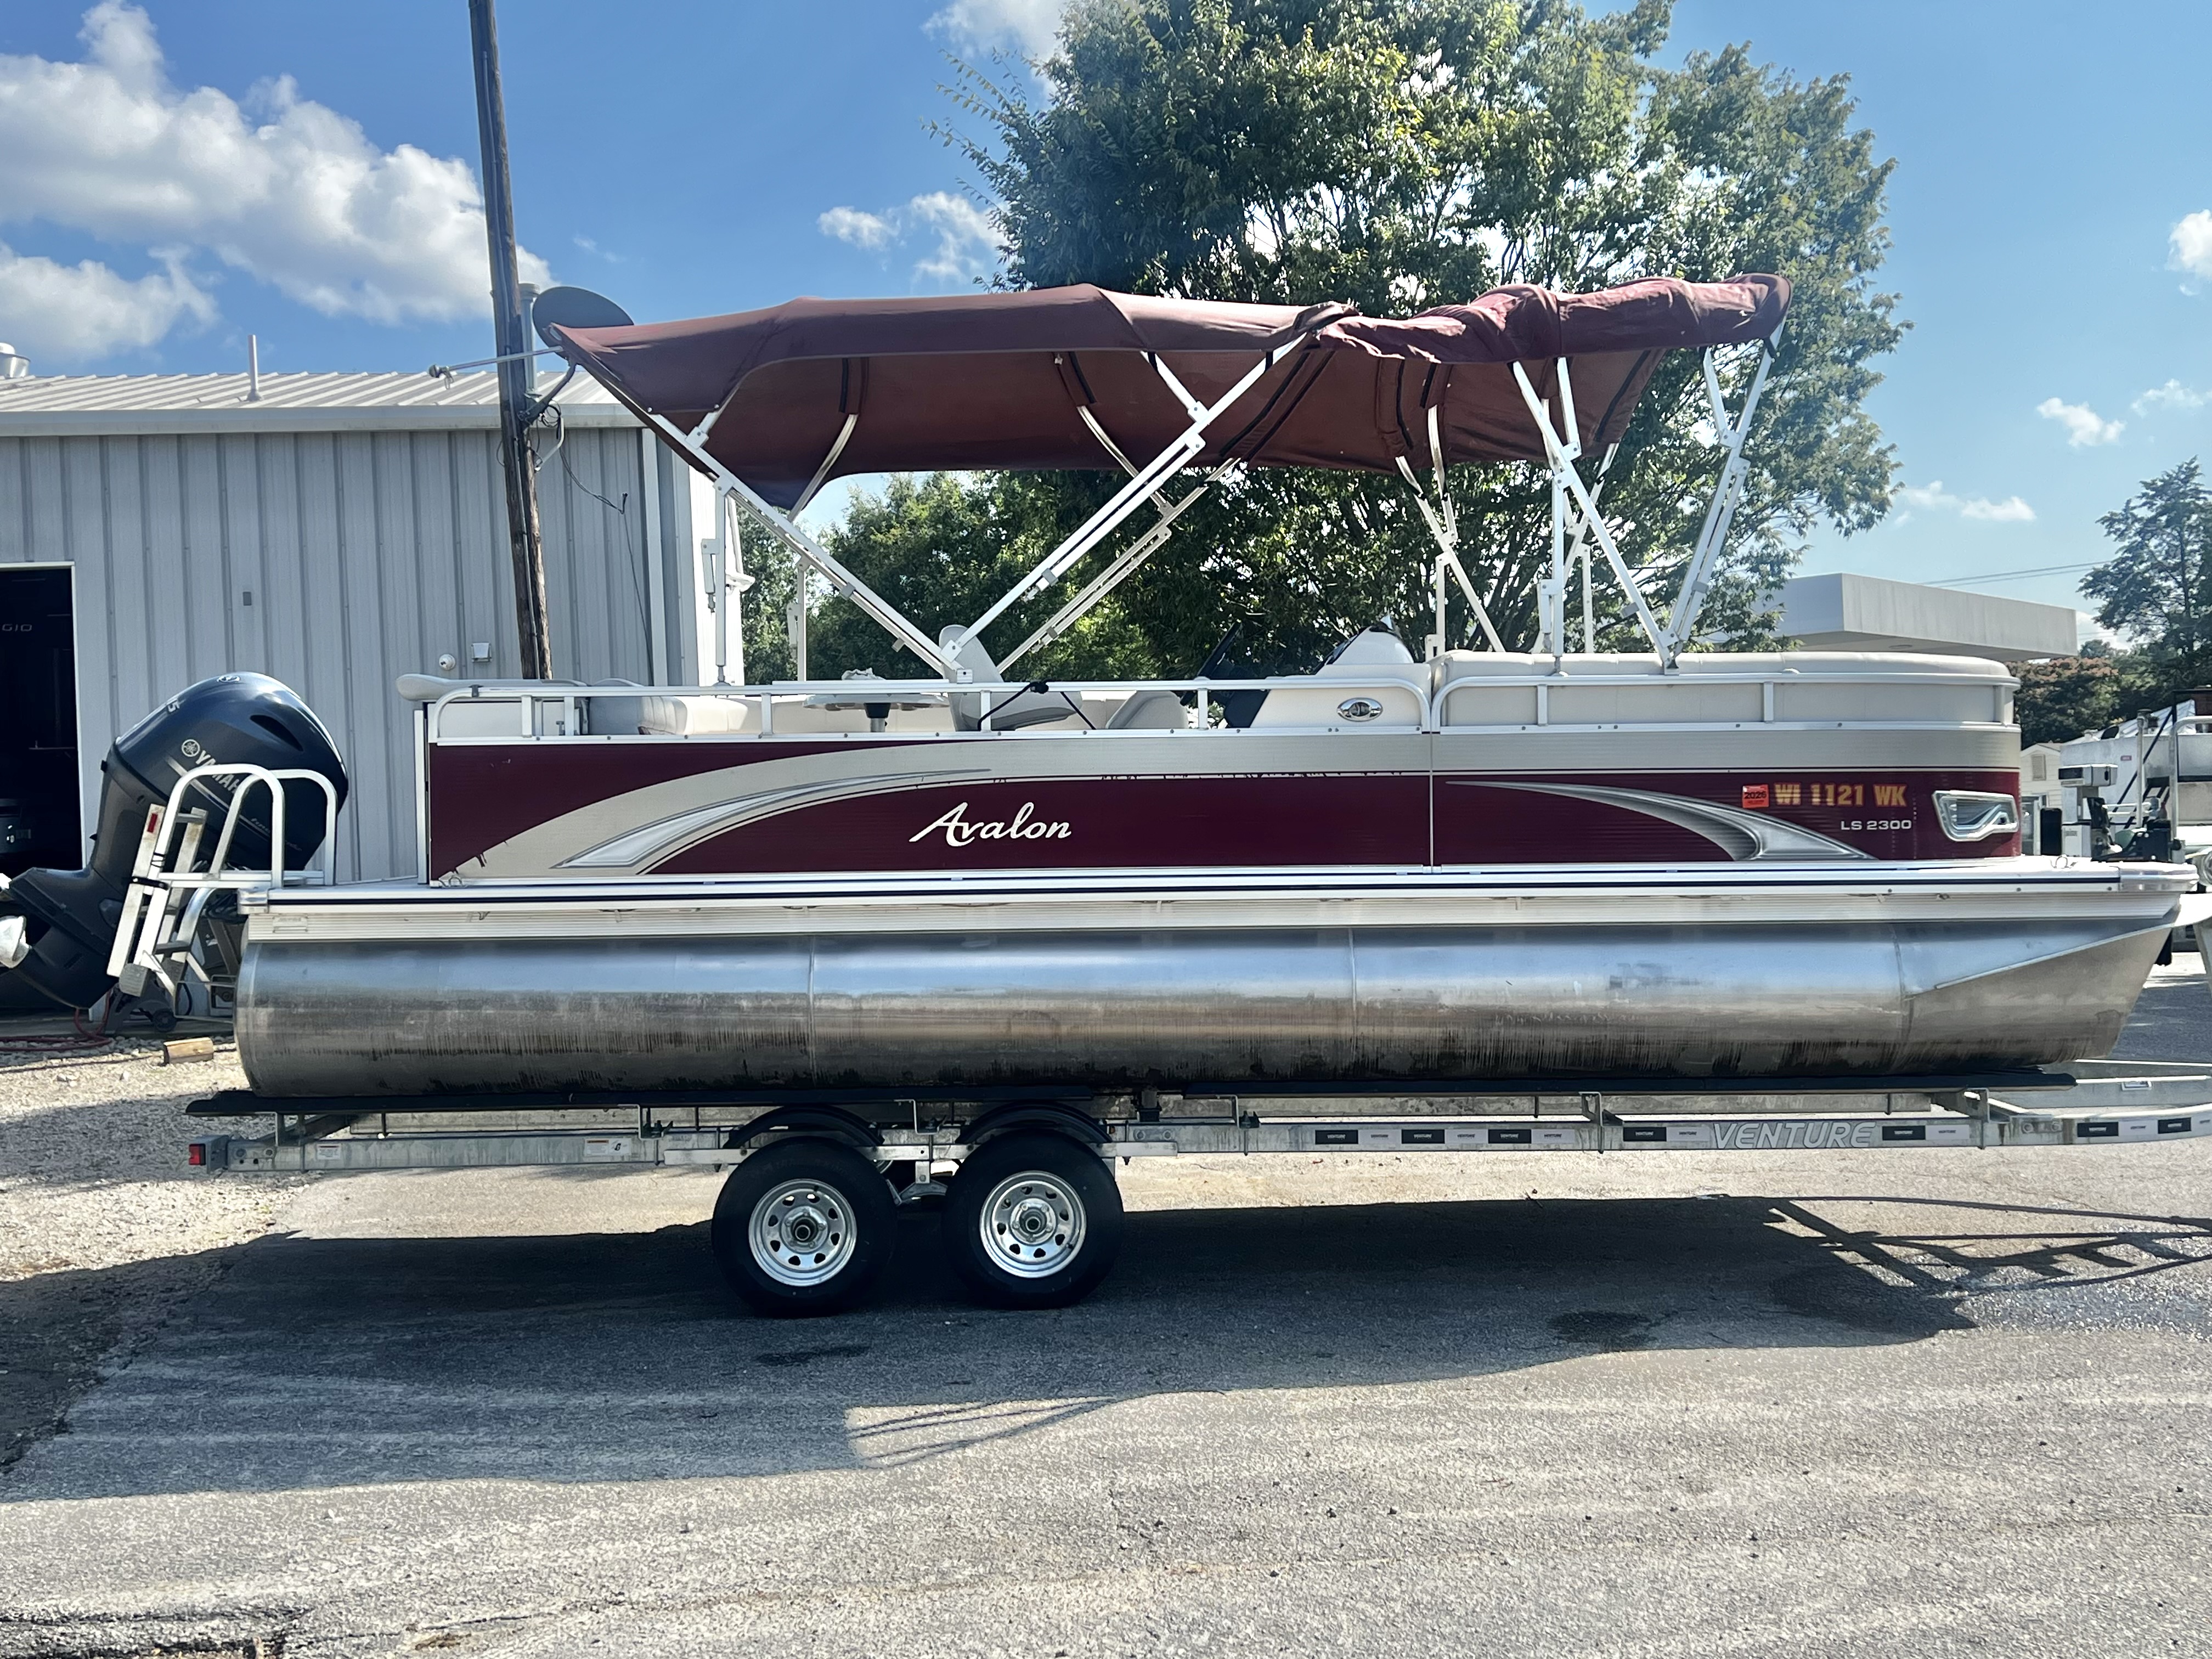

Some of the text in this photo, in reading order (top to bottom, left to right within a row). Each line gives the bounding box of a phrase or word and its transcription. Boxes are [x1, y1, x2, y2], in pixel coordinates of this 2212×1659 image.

[195, 750, 242, 794] YAAH
[1743, 791, 1767, 799] 2026
[1774, 783, 1908, 807] WI 1121 WK
[909, 802, 1072, 847] Avalon
[1841, 819, 1912, 831] LS 2300
[1713, 1121, 1876, 1149] VENTURE
